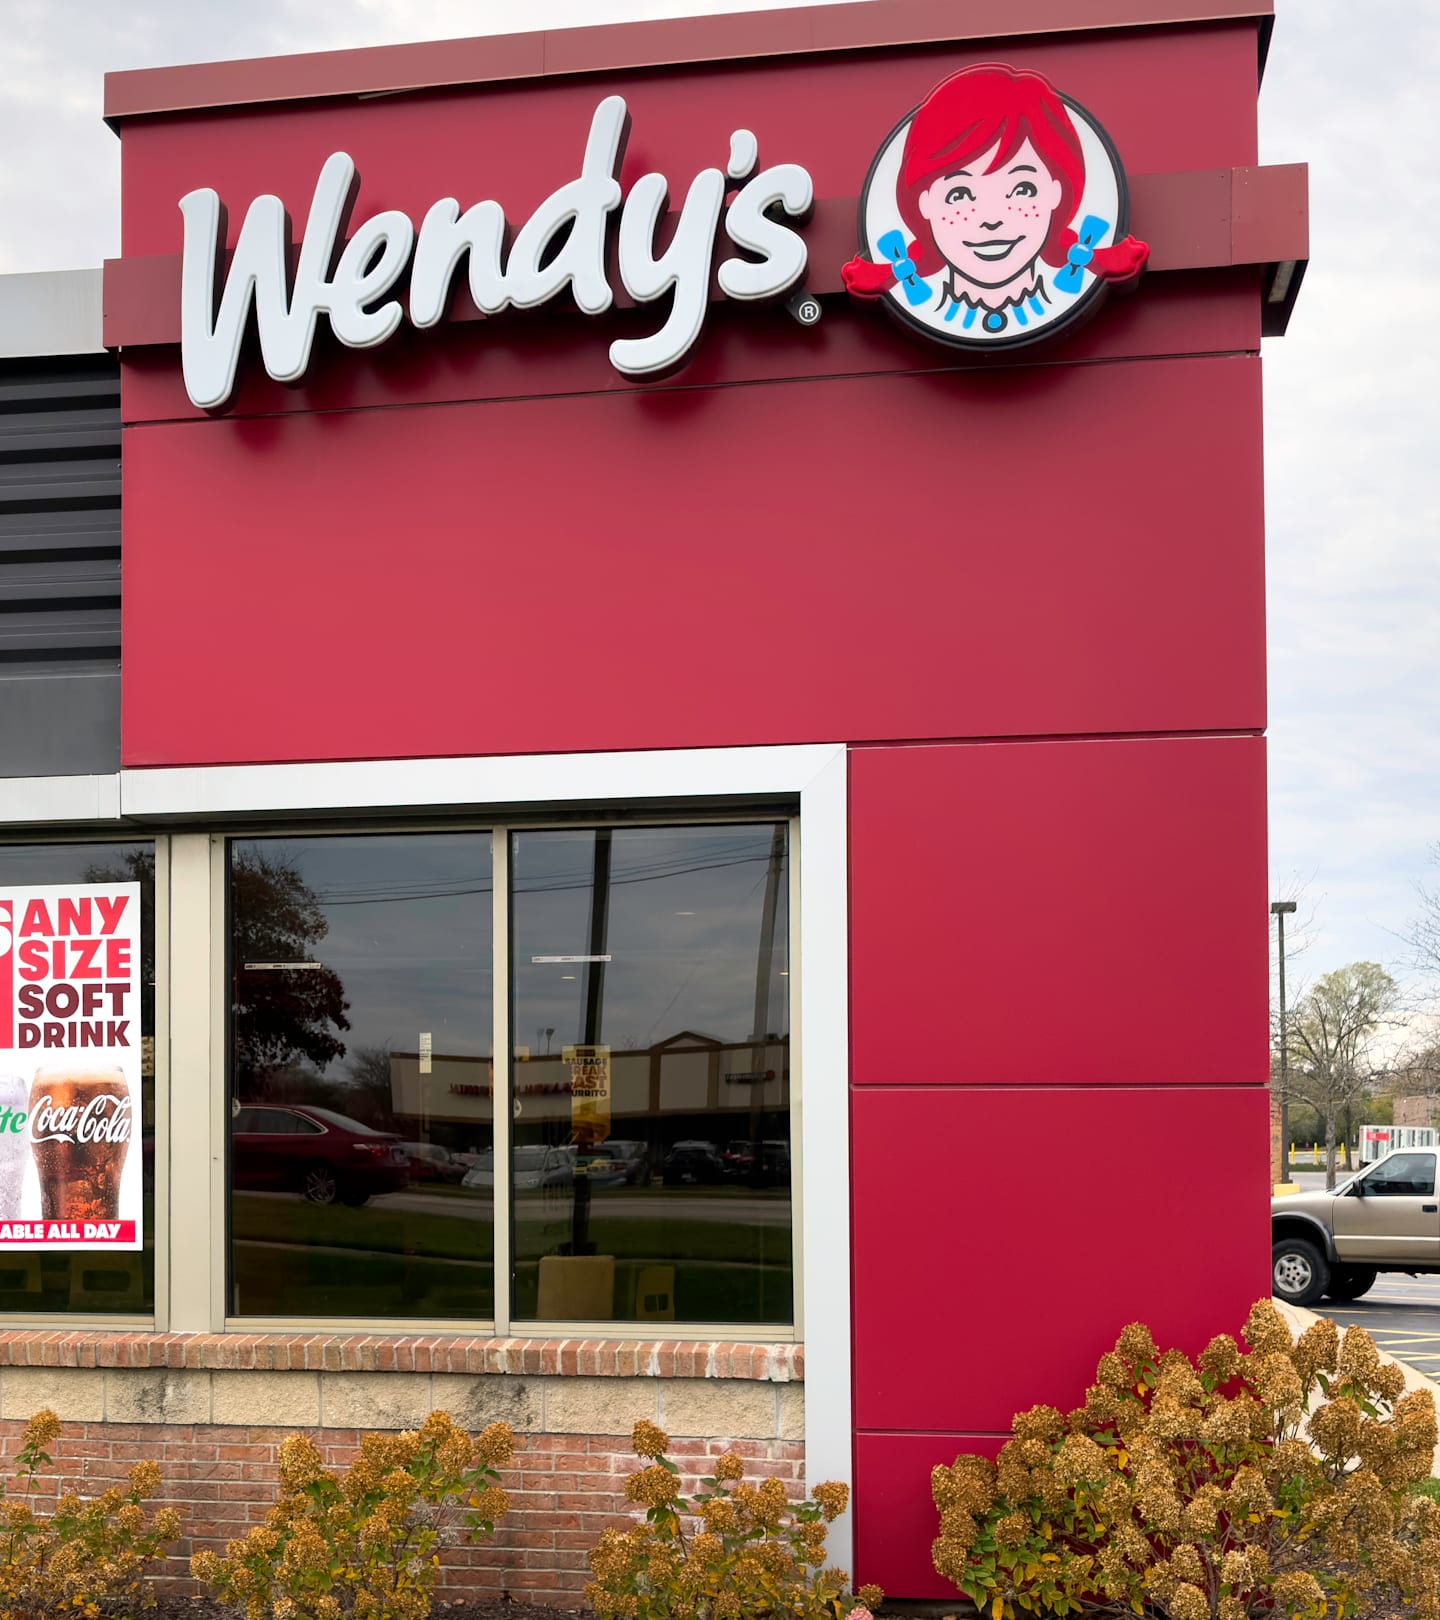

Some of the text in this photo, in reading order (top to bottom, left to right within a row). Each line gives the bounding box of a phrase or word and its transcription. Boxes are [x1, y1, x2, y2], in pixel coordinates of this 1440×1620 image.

[178, 95, 813, 408] Wendy's
[18, 896, 130, 937] ANY
[18, 938, 131, 981] SIZE
[18, 983, 131, 1019] SOFT
[18, 1021, 131, 1049] DRINK
[571, 1089, 607, 1097] URRITO
[47, 1224, 80, 1239] ALL
[84, 1223, 121, 1239] DAY
